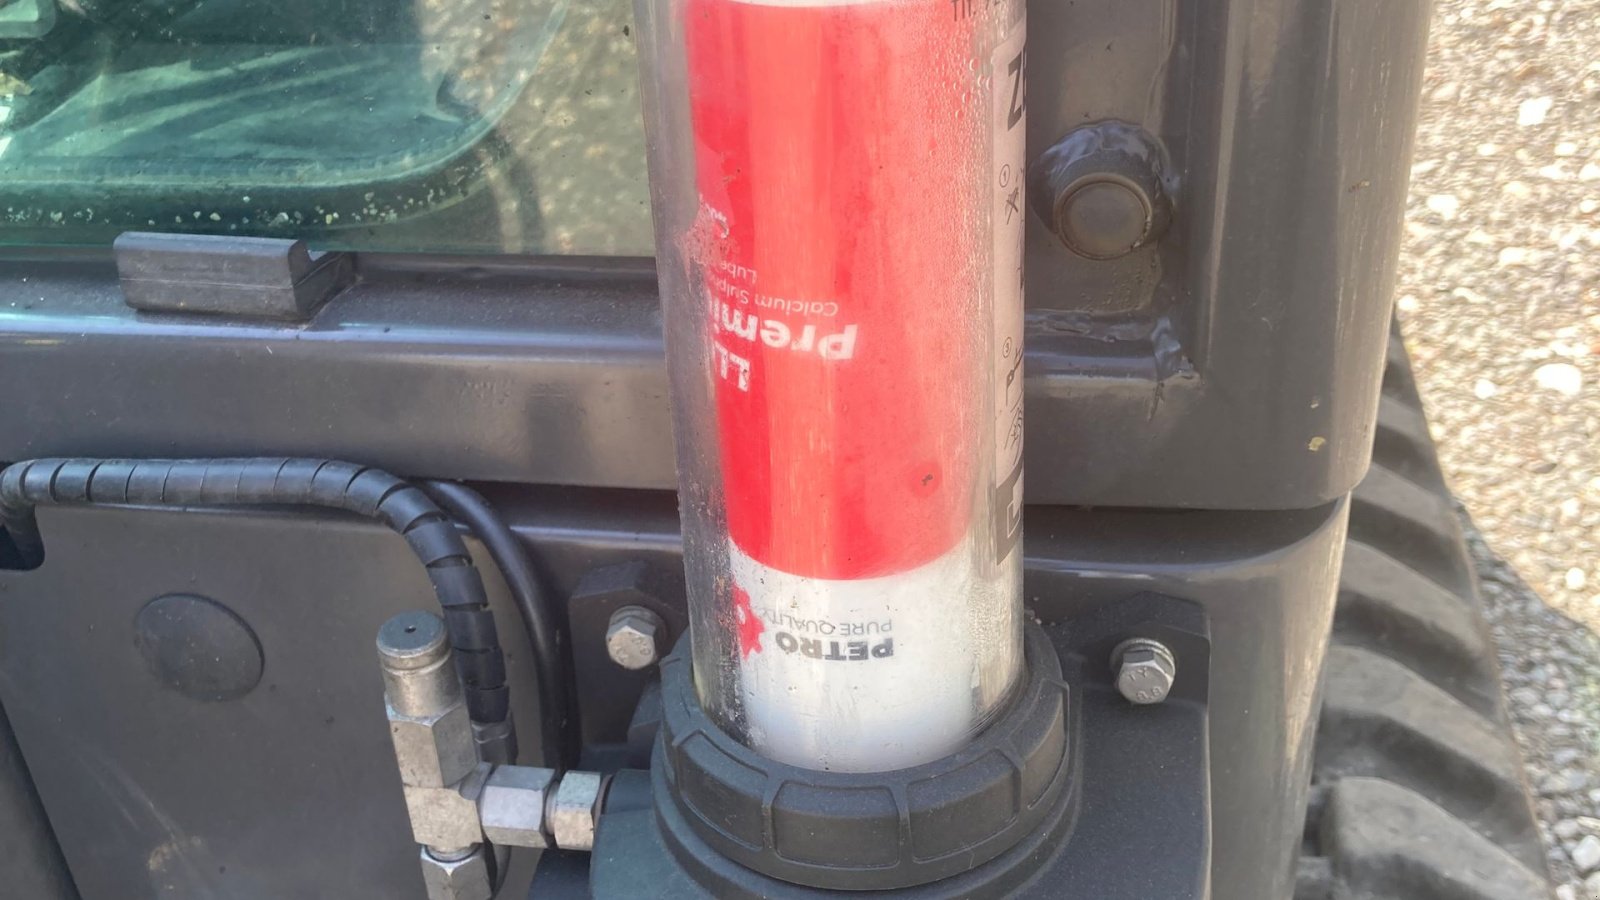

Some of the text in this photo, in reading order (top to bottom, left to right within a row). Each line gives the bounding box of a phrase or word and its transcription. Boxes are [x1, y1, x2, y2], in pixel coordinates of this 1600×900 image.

[755, 296, 839, 317] Calcium
[841, 619, 893, 636] PURE
[775, 631, 894, 661] PETRO
